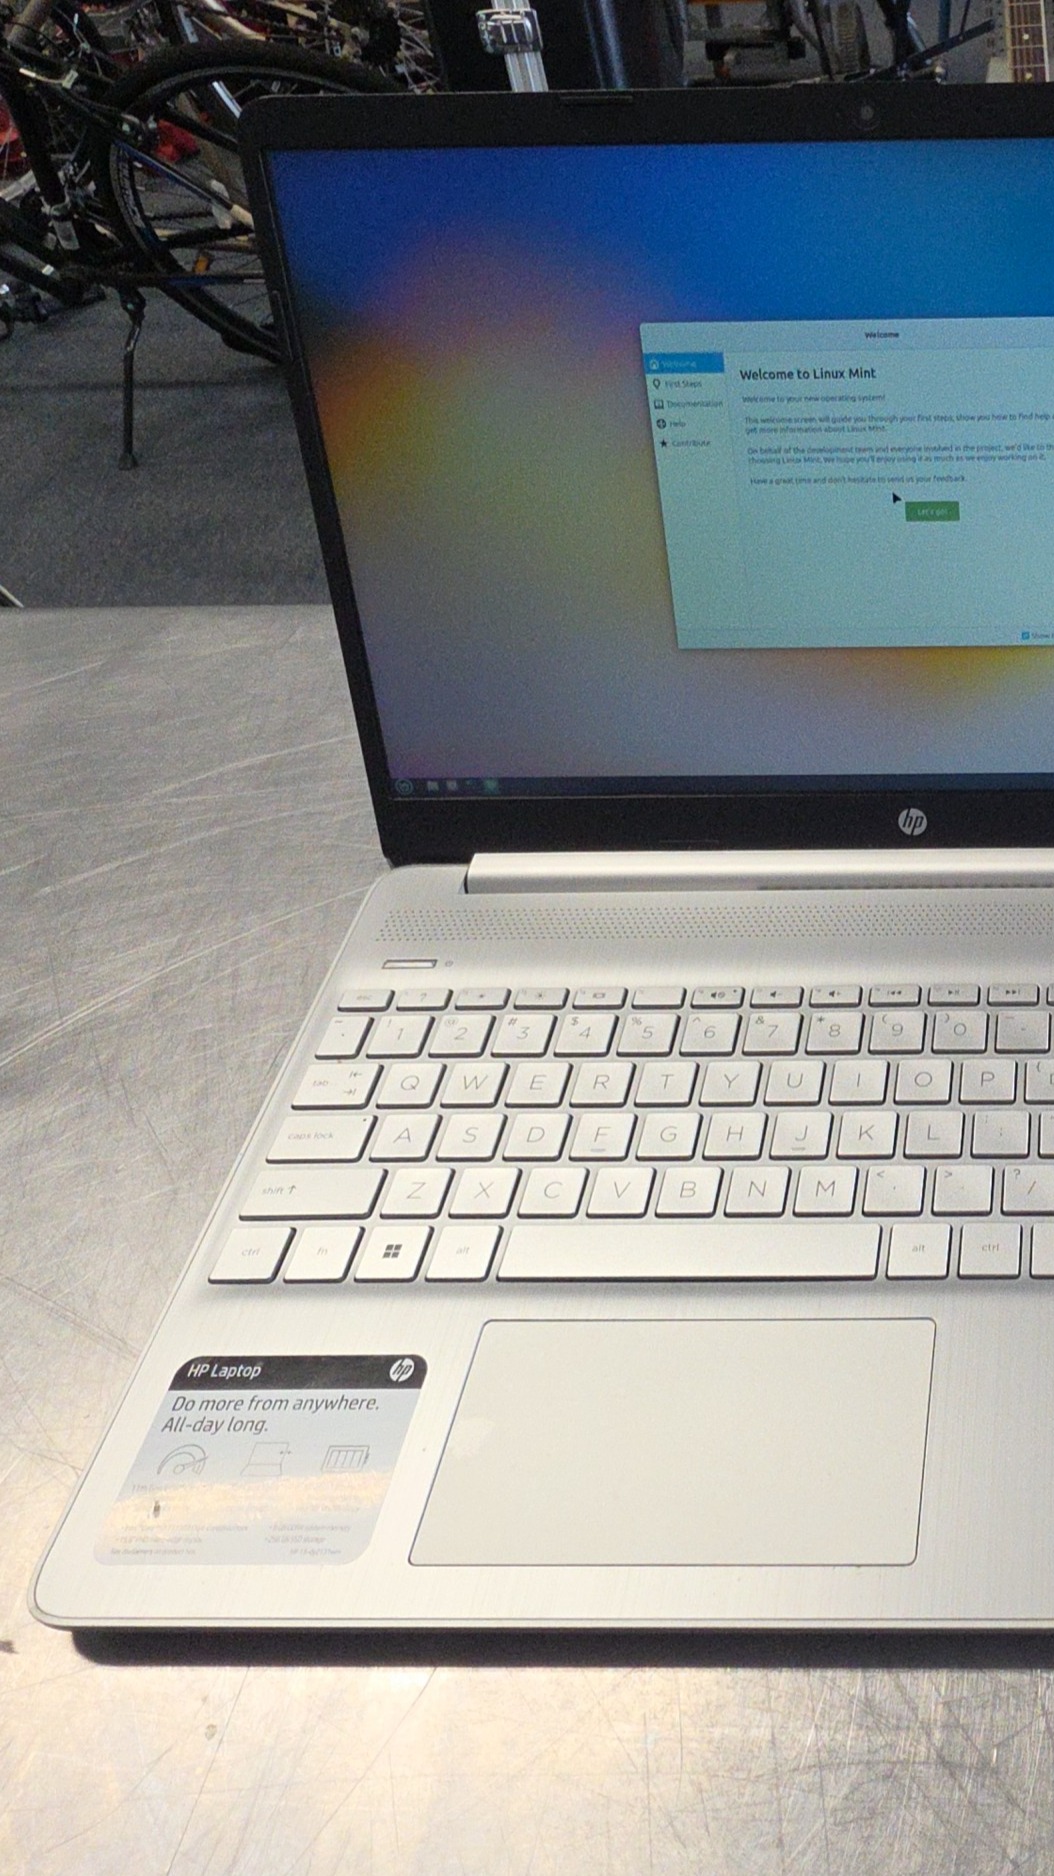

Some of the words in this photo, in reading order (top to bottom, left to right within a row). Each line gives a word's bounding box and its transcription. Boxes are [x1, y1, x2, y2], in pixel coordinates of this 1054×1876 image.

[865, 330, 900, 338] Welcome
[740, 368, 794, 380] Welcome
[797, 368, 810, 380] to
[813, 367, 845, 379] Linux
[848, 366, 877, 379] Mint
[667, 400, 723, 408] Documentation
[670, 420, 686, 428] Help
[901, 808, 926, 836] hp
[396, 1028, 403, 1040] 1
[454, 1027, 469, 1040] 2
[517, 1027, 530, 1040] 3
[578, 1027, 592, 1040] 4
[642, 1026, 654, 1039] 5
[704, 1025, 716, 1039] 6
[767, 1025, 778, 1038] 7
[828, 1024, 841, 1038] 8
[892, 1024, 904, 1037] 9
[312, 1078, 329, 1087] tab
[400, 1075, 419, 1091] Q
[463, 1075, 488, 1091] W
[530, 1075, 547, 1091] E
[593, 1074, 610, 1090] R
[661, 1074, 674, 1089] T
[724, 1073, 740, 1089] Y
[787, 1073, 803, 1088] U
[980, 1071, 995, 1087] P
[287, 1133, 311, 1142] caps
[313, 1131, 334, 1140] lock
[393, 1128, 412, 1143] A
[462, 1127, 479, 1143] S
[526, 1127, 545, 1143] D
[594, 1126, 611, 1142] F
[660, 1126, 677, 1142] G
[726, 1126, 744, 1141] H
[795, 1125, 808, 1141] J
[858, 1125, 875, 1141] K
[927, 1125, 940, 1140] L
[262, 1185, 284, 1195] shift
[406, 1182, 425, 1199] Z
[474, 1182, 494, 1199] X
[544, 1181, 563, 1198] C
[613, 1181, 631, 1198] V
[680, 1181, 696, 1198] B
[748, 1181, 767, 1197] N
[815, 1180, 836, 1197] M
[241, 1247, 260, 1256] ctrl
[316, 1247, 328, 1255] fn
[456, 1246, 469, 1255] alt
[912, 1244, 925, 1252] alt
[982, 1243, 1000, 1252] ctrl
[187, 1363, 208, 1378] HP
[210, 1363, 262, 1380] Laptop
[390, 1358, 413, 1382] hp
[172, 1396, 195, 1412] Do
[199, 1399, 243, 1411] more
[248, 1395, 288, 1411] from
[292, 1395, 379, 1413] anywhere.
[161, 1417, 224, 1435] All-day
[227, 1416, 268, 1435] long.
